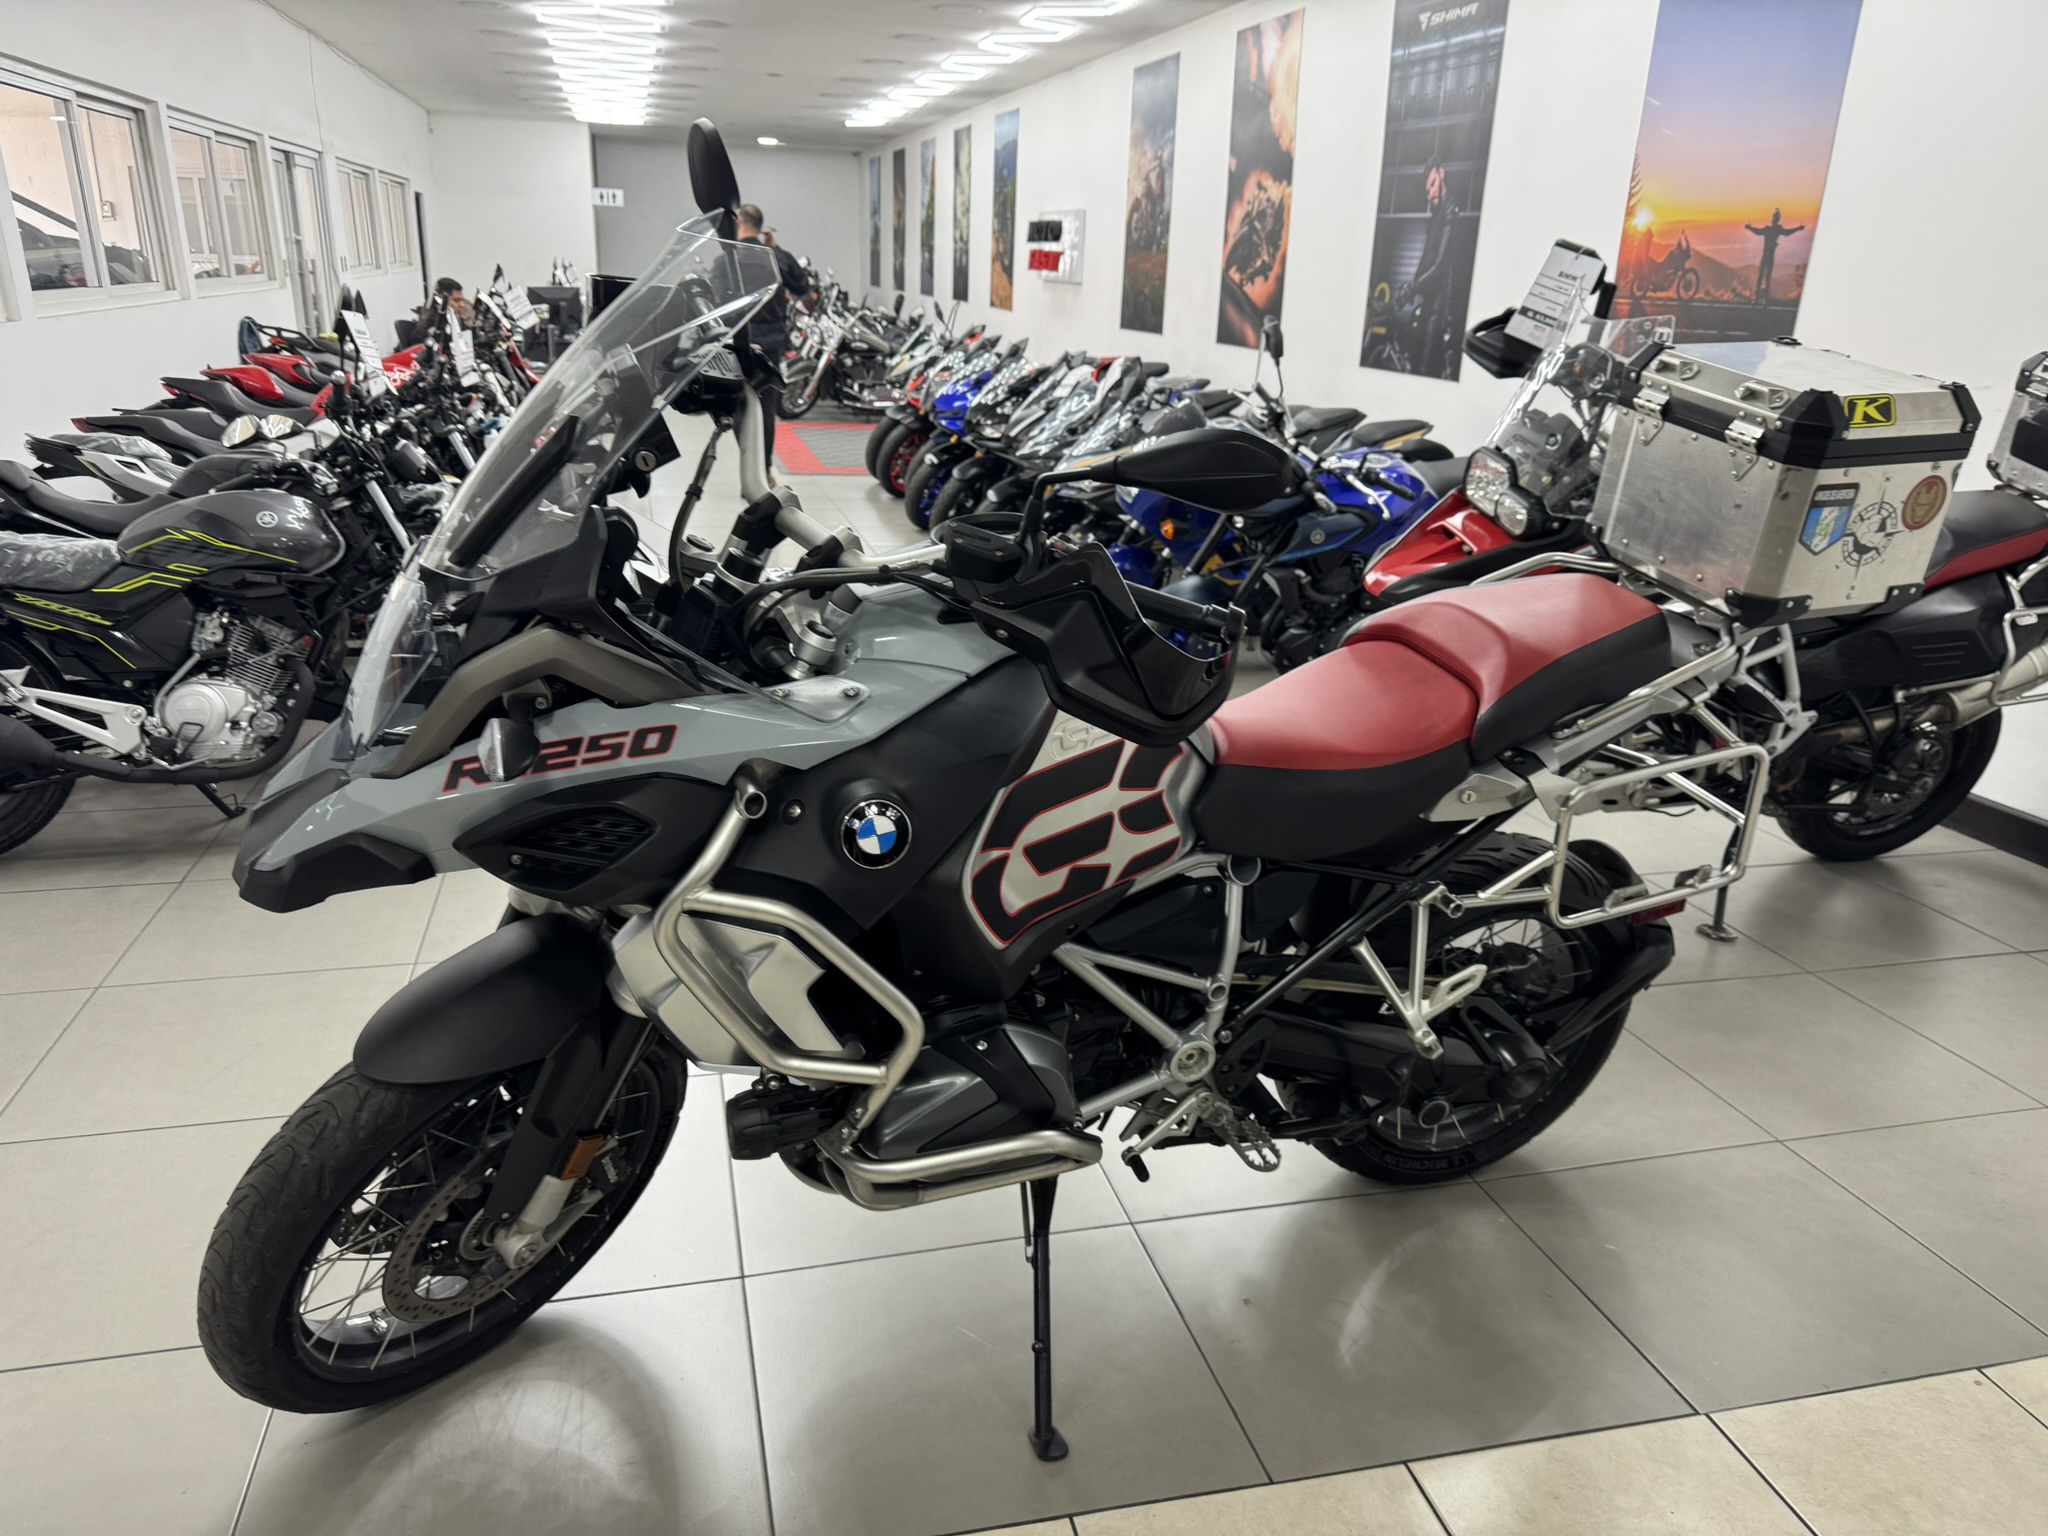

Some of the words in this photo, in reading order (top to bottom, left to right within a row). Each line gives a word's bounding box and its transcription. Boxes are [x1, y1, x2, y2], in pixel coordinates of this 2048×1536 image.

[1429, 2, 1479, 26] SHIMA
[442, 724, 678, 793] R250
[847, 804, 901, 830] BMW
